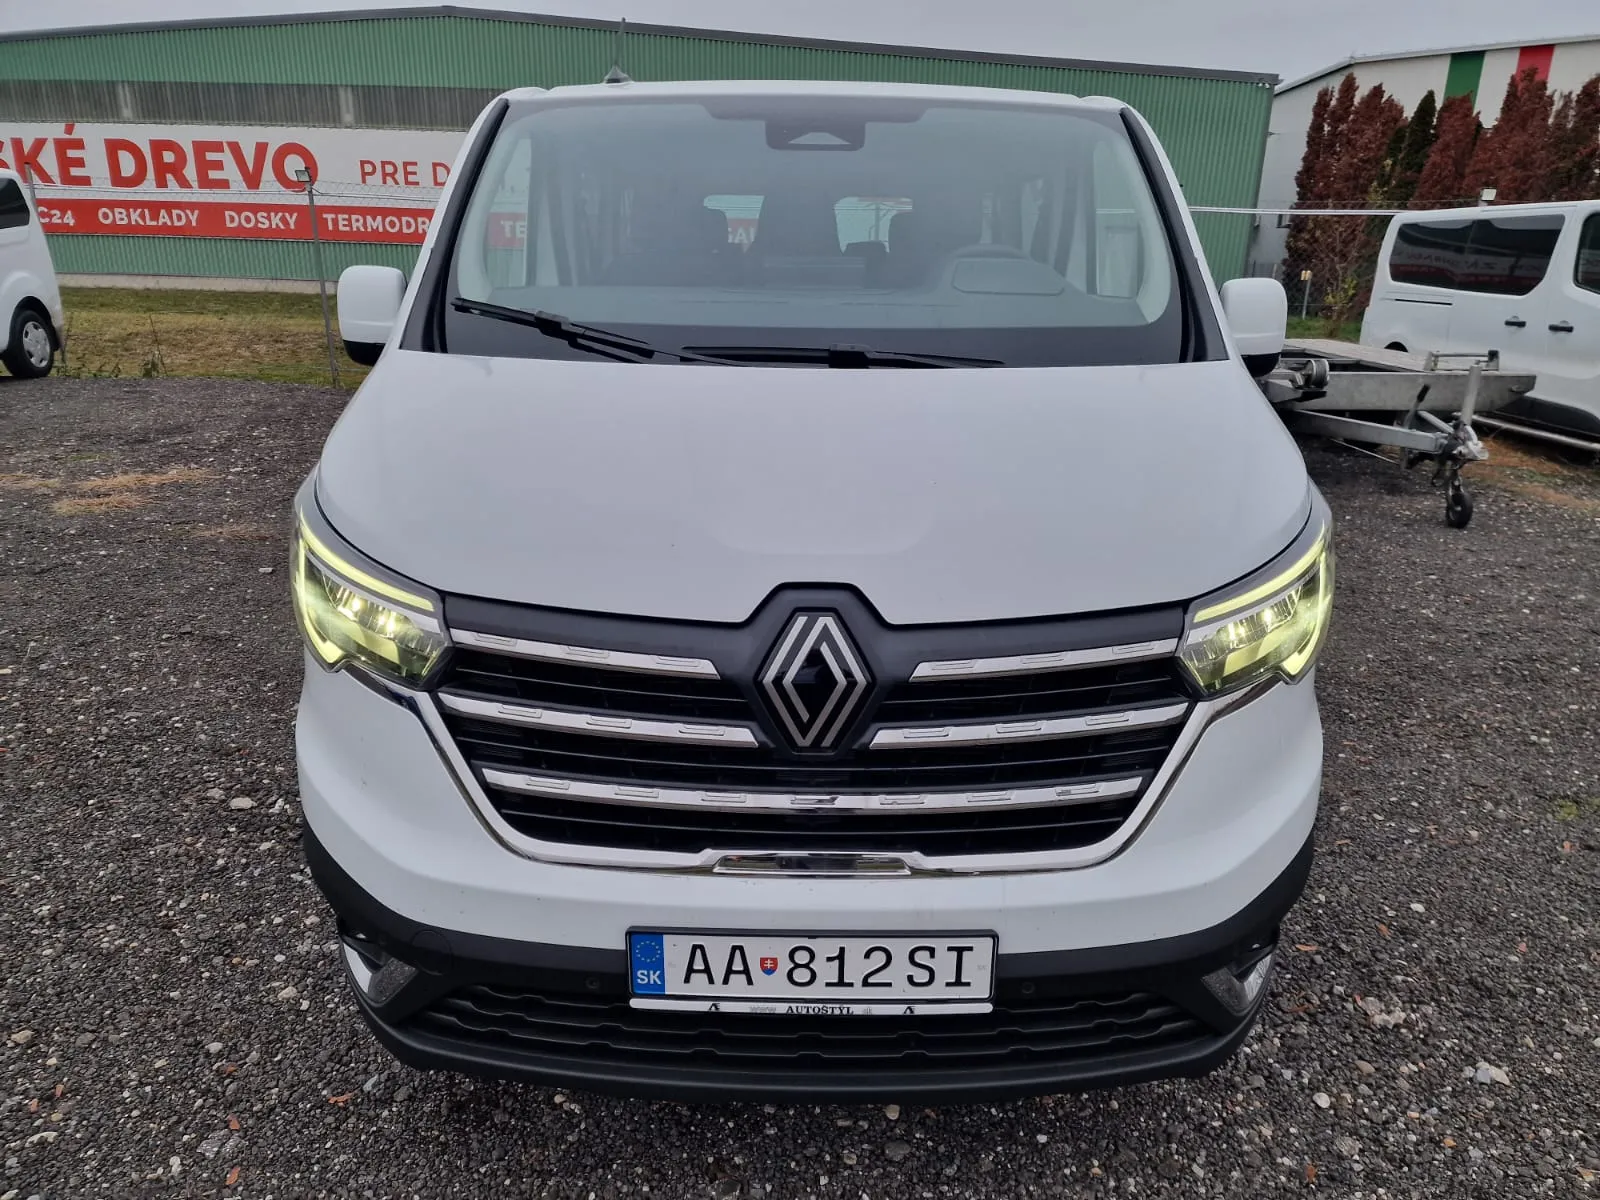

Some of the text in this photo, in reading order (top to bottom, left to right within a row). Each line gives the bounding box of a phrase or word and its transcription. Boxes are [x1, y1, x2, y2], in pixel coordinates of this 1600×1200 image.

[104, 138, 318, 192] DREVO
[359, 160, 420, 186] PRE
[37, 206, 75, 227] C24
[98, 207, 199, 227] OBKLADY
[225, 210, 298, 230] DOSKY
[636, 969, 662, 985] SK
